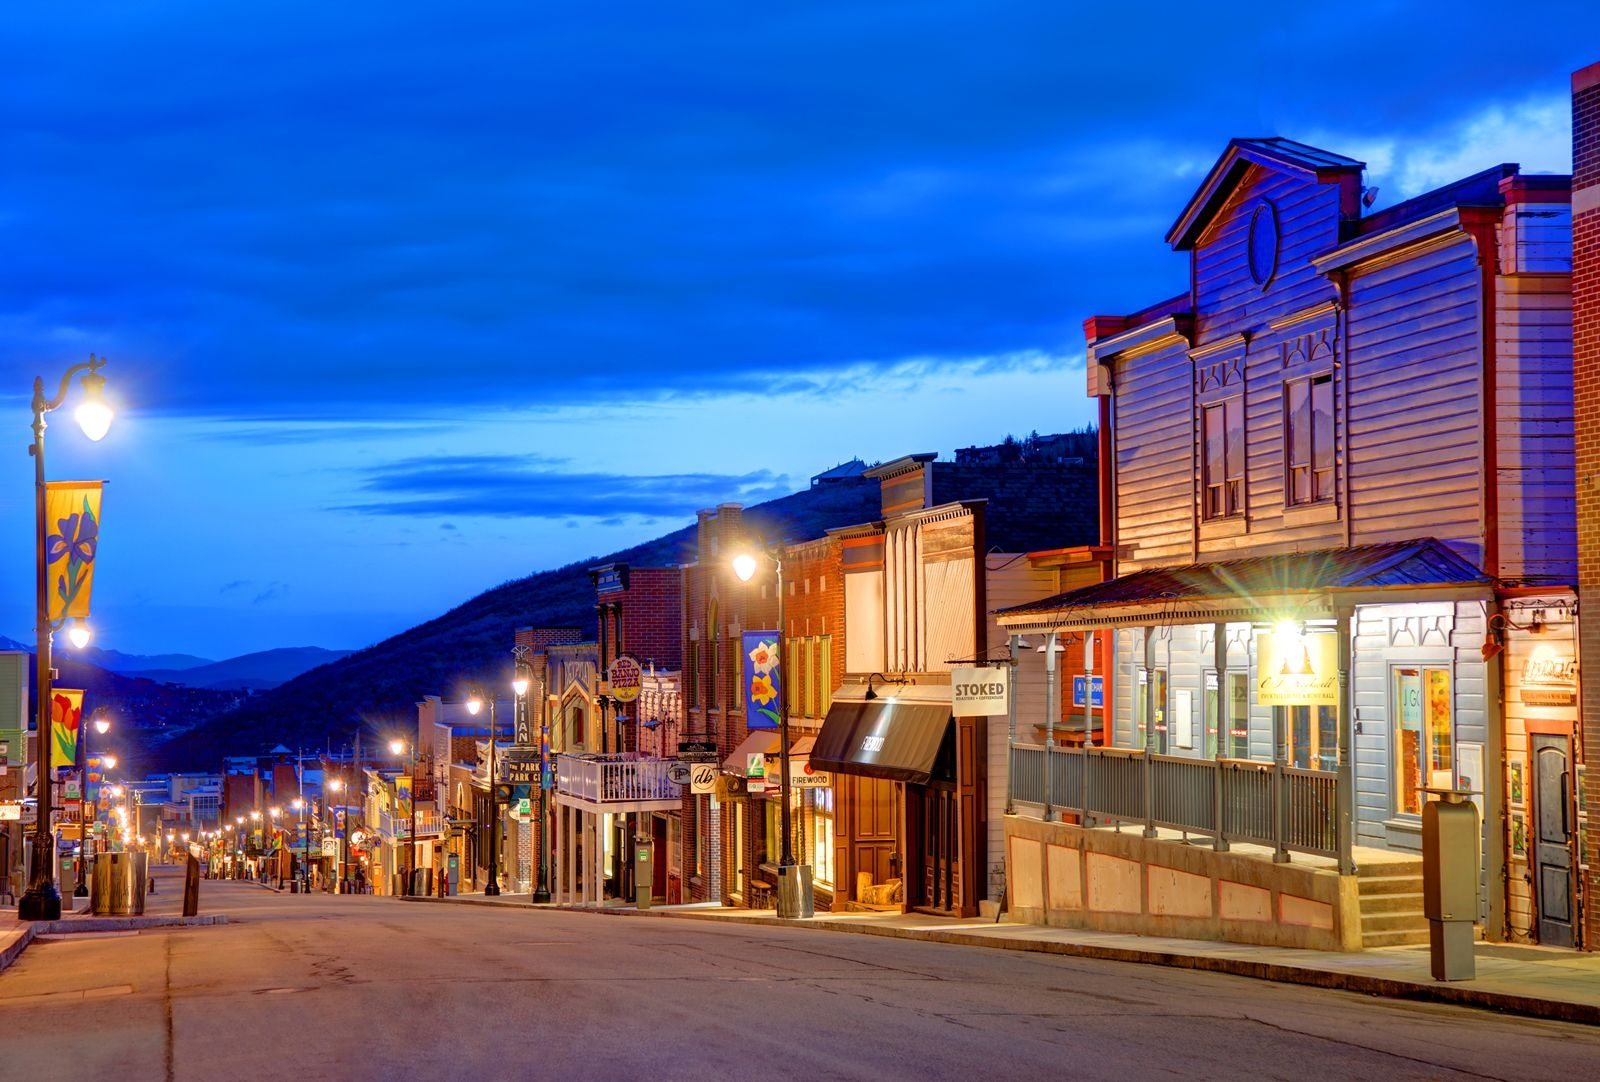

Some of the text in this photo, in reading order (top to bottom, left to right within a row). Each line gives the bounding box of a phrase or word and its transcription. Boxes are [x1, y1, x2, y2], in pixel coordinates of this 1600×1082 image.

[617, 660, 632, 668] RED
[611, 668, 640, 679] BANJO
[612, 678, 640, 688] PIZZA
[955, 682, 1004, 697] STOKED
[520, 762, 540, 772] PARK
[509, 773, 530, 782] PARK
[694, 768, 713, 785] db
[792, 776, 828, 784] FIREWOOD
